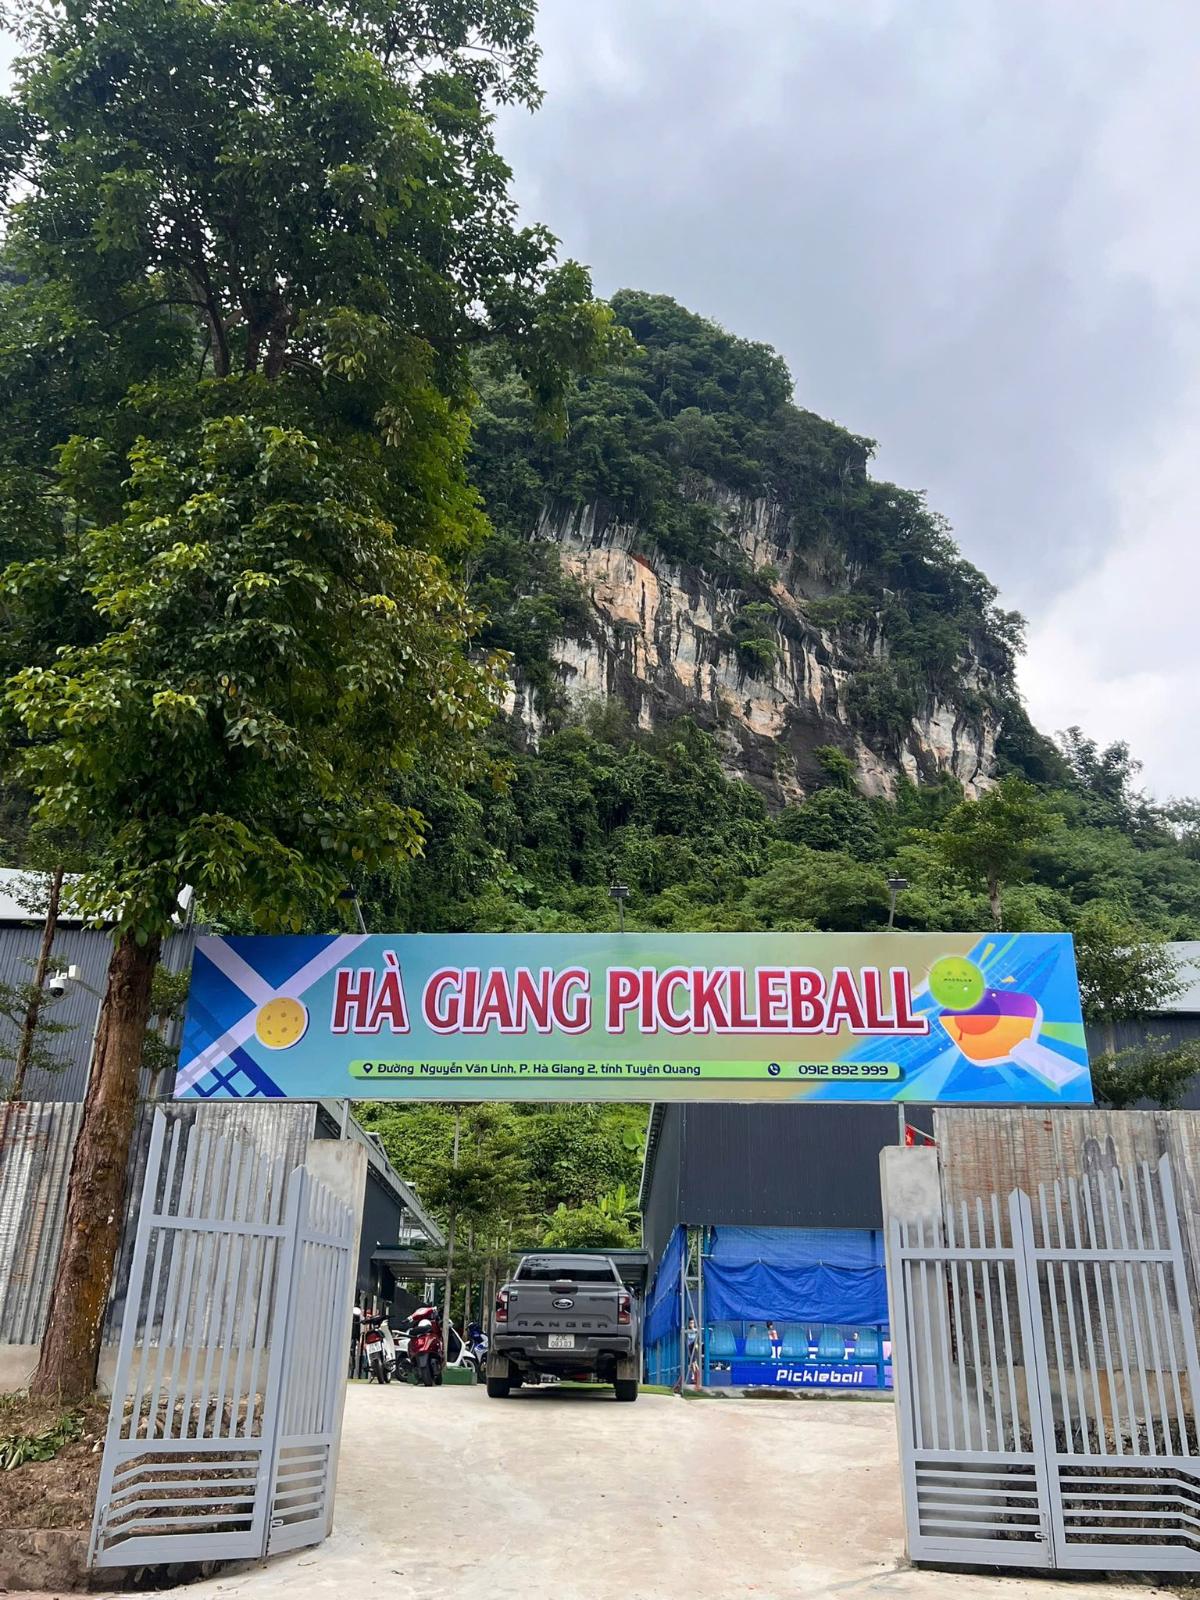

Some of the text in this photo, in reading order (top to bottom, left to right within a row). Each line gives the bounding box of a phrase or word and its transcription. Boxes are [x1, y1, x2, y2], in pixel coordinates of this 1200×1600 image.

[330, 950, 930, 1035] HÀ GIANG PICKLEBALL
[378, 1063, 414, 1075] Đường
[420, 1062, 463, 1075] Nguyễn
[465, 1063, 488, 1073] Văn
[519, 1063, 530, 1074] P.
[533, 1063, 548, 1073] Hà
[552, 1063, 585, 1075] Giang
[625, 1064, 660, 1076] Tuyên
[663, 1064, 701, 1076] Quang
[798, 1065, 889, 1075] 0912 892 999
[517, 1320, 608, 1328] RANGER
[776, 1369, 863, 1383] Pickleball
